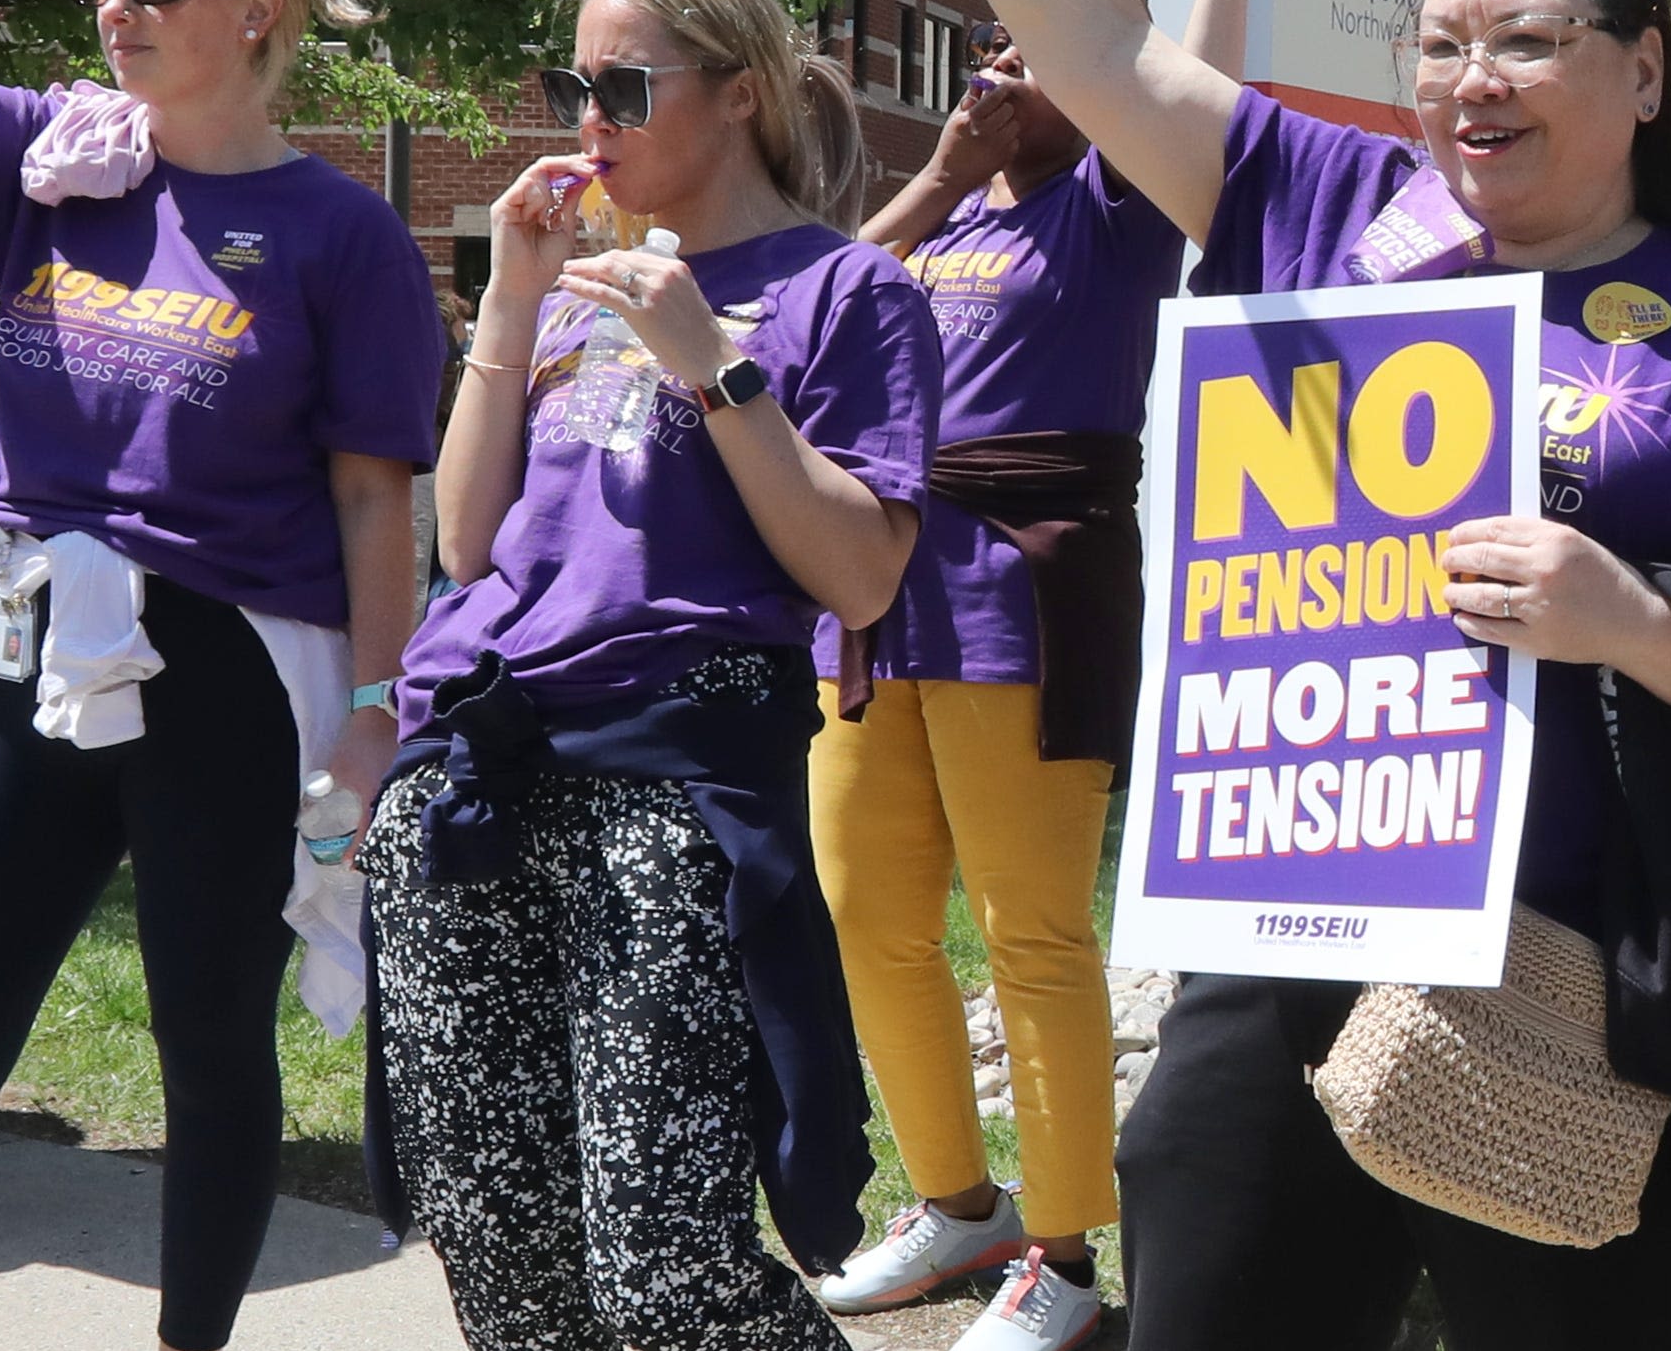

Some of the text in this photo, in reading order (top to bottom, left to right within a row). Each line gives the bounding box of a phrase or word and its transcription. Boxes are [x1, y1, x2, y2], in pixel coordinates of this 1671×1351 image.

[223, 230, 264, 242] UNITED
[975, 279, 1001, 295] East
[53, 301, 131, 330] Healthcare
[137, 320, 199, 347] Workers
[205, 337, 239, 359] East
[951, 303, 997, 322] AND
[954, 322, 989, 341] ALL
[54, 355, 117, 384] JOBS
[119, 369, 171, 395] FOR
[170, 382, 216, 410] ALL
[97, 341, 168, 370] CARE
[168, 358, 228, 387] AND
[641, 421, 683, 455] ALL
[1193, 340, 1495, 543] NO
[1542, 435, 1592, 465] East
[1183, 529, 1465, 643] PENSION
[1175, 646, 1490, 754] MORE
[1172, 748, 1483, 862] TENSION!
[1255, 914, 1369, 939] 1199SEIU
